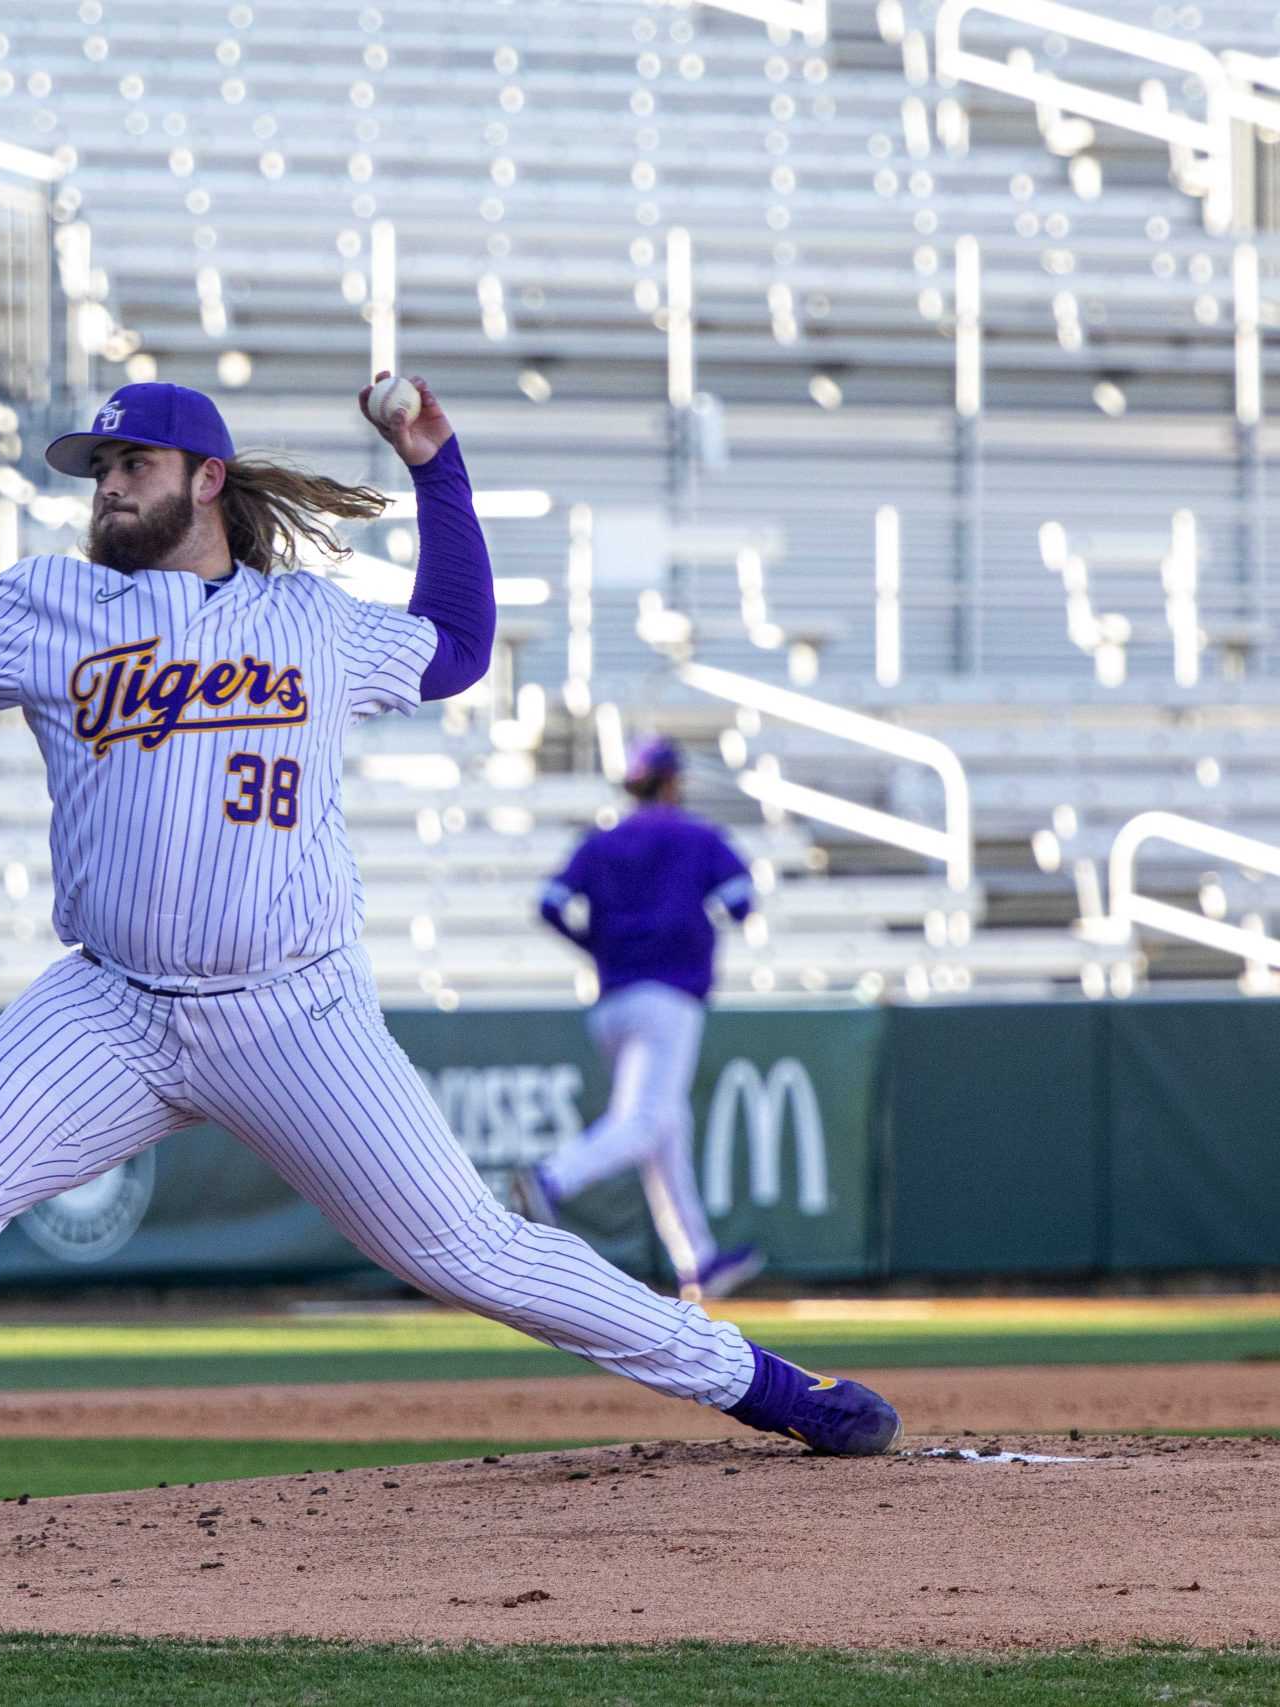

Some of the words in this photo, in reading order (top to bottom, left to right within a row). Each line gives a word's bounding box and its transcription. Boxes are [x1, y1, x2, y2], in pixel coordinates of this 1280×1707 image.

[69, 635, 309, 760] Tigers
[224, 752, 301, 832] 38
[414, 1064, 585, 1164] USES
